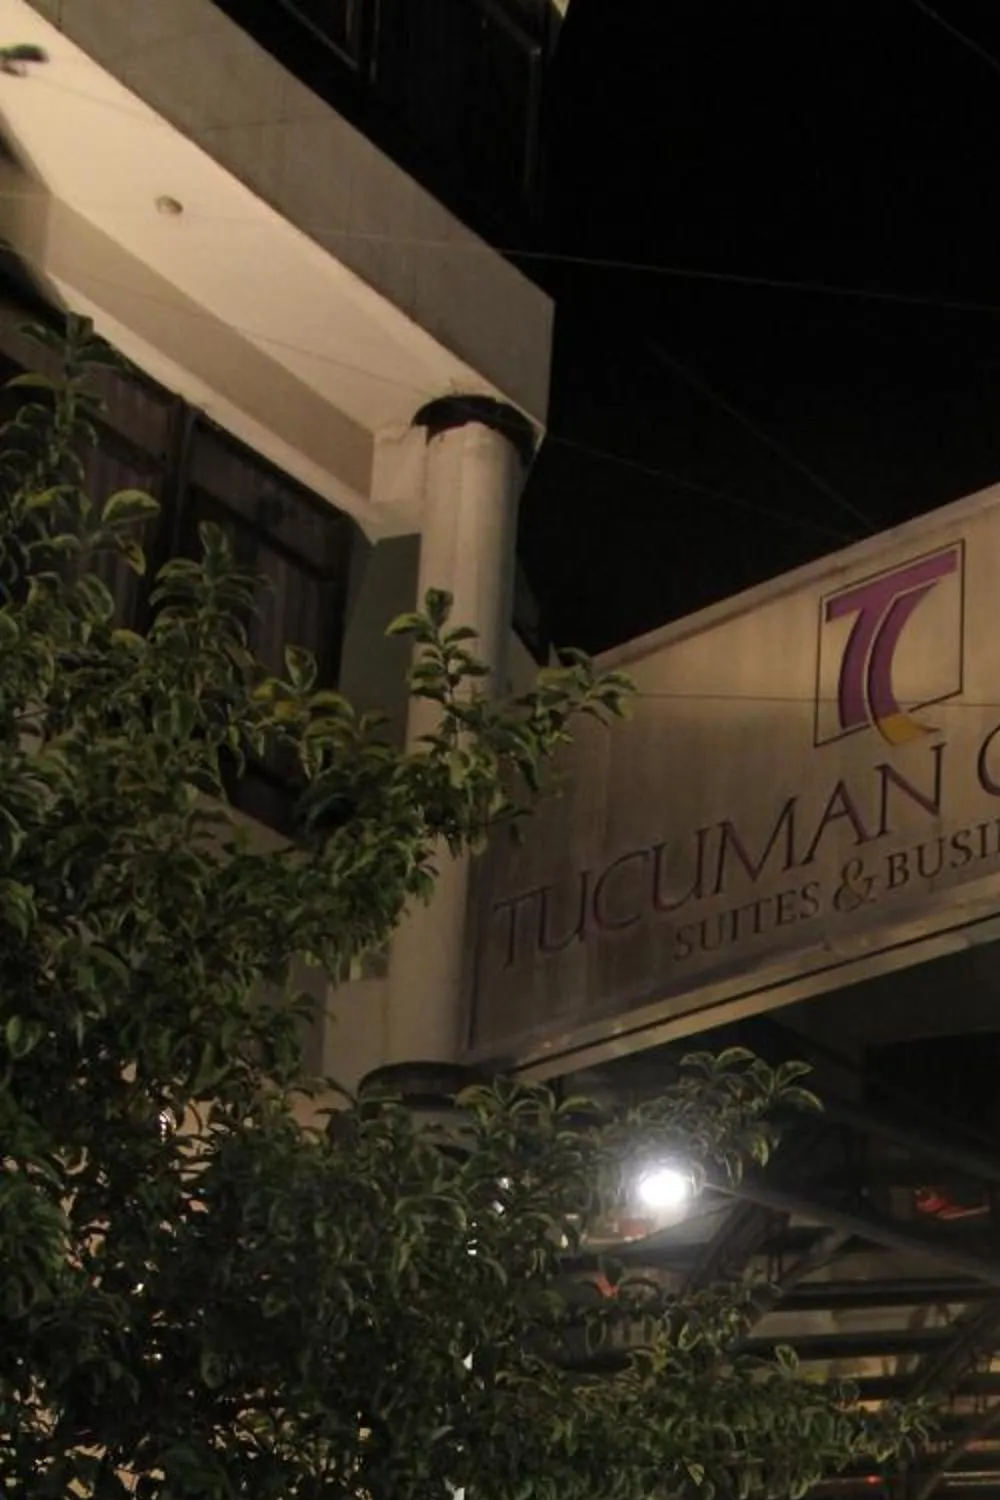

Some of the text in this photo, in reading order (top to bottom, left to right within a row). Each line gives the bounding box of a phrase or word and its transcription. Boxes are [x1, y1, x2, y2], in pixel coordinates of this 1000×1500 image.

[494, 742, 948, 970] TUCUMAN
[673, 881, 820, 961] SUITES
[833, 857, 879, 913] &
